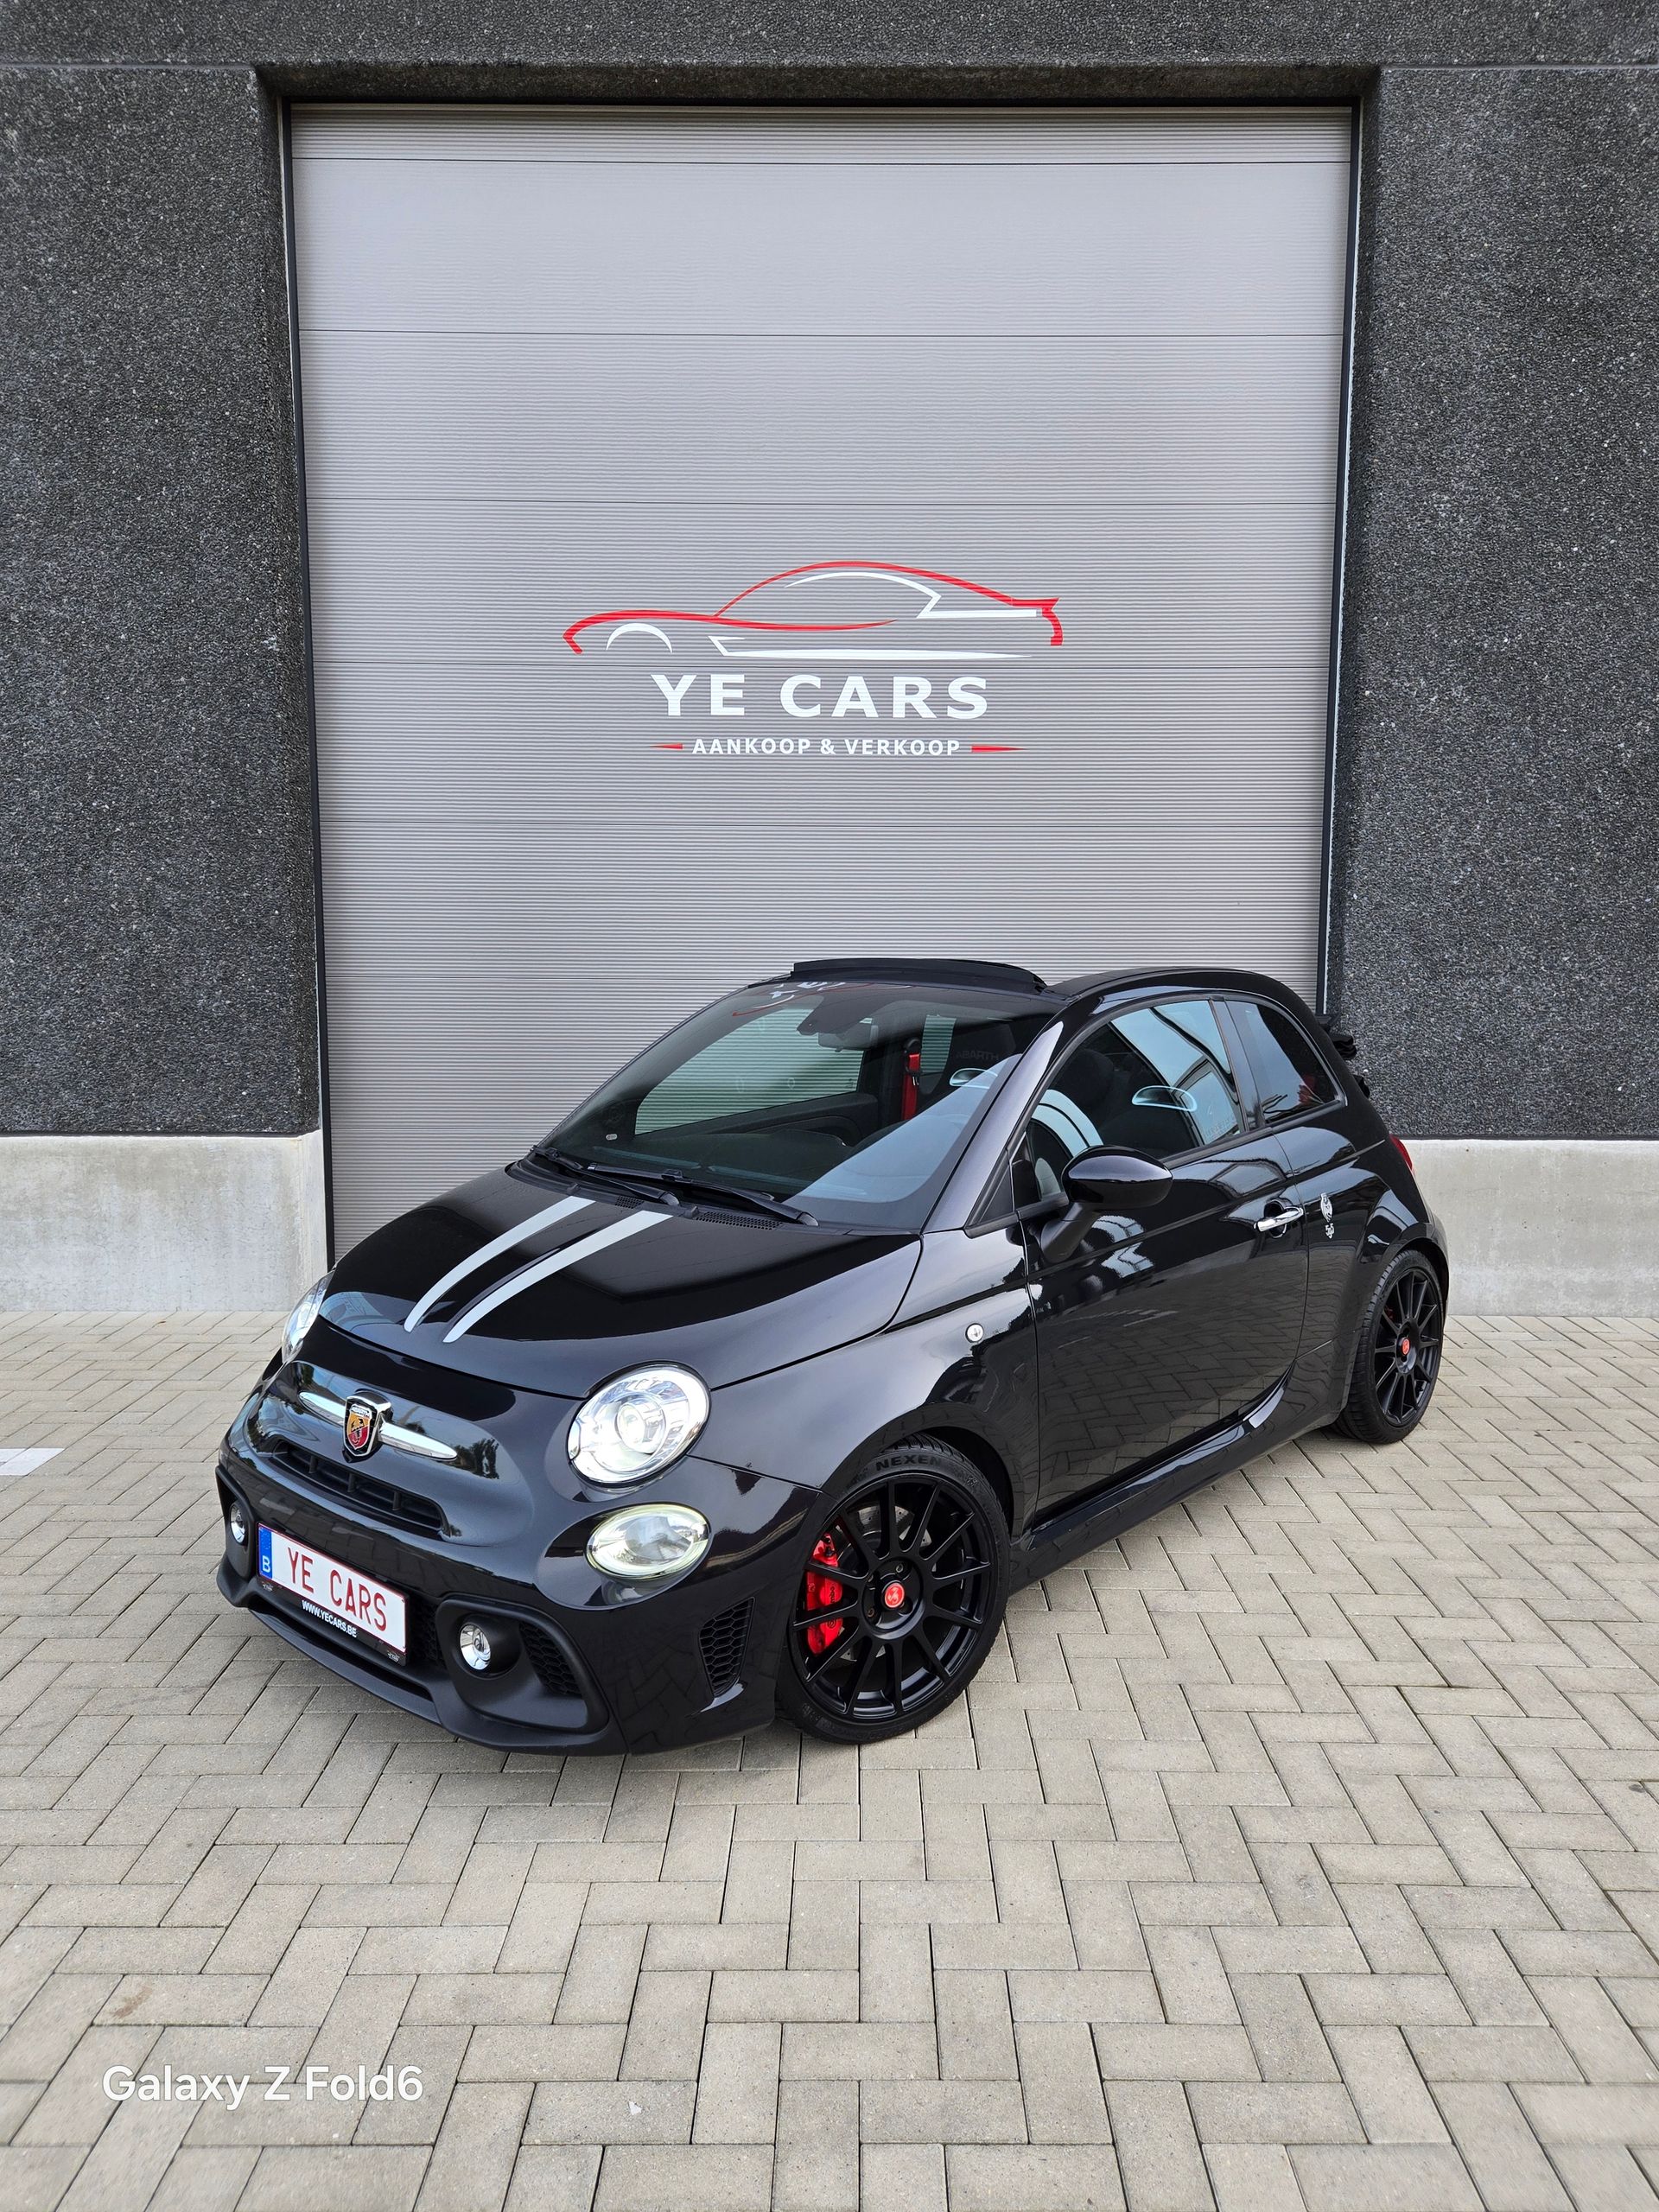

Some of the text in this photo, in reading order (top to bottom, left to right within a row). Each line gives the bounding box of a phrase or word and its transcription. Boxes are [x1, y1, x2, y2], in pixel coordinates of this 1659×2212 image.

[651, 674, 988, 720] YE CARS
[691, 738, 961, 756] AANKOOP & VERKOOP
[875, 1455, 942, 1471] NEXEN
[262, 1555, 270, 1573] B
[287, 1547, 387, 1632] YE CARS
[302, 1599, 357, 1638] WWW.YECARS.BE
